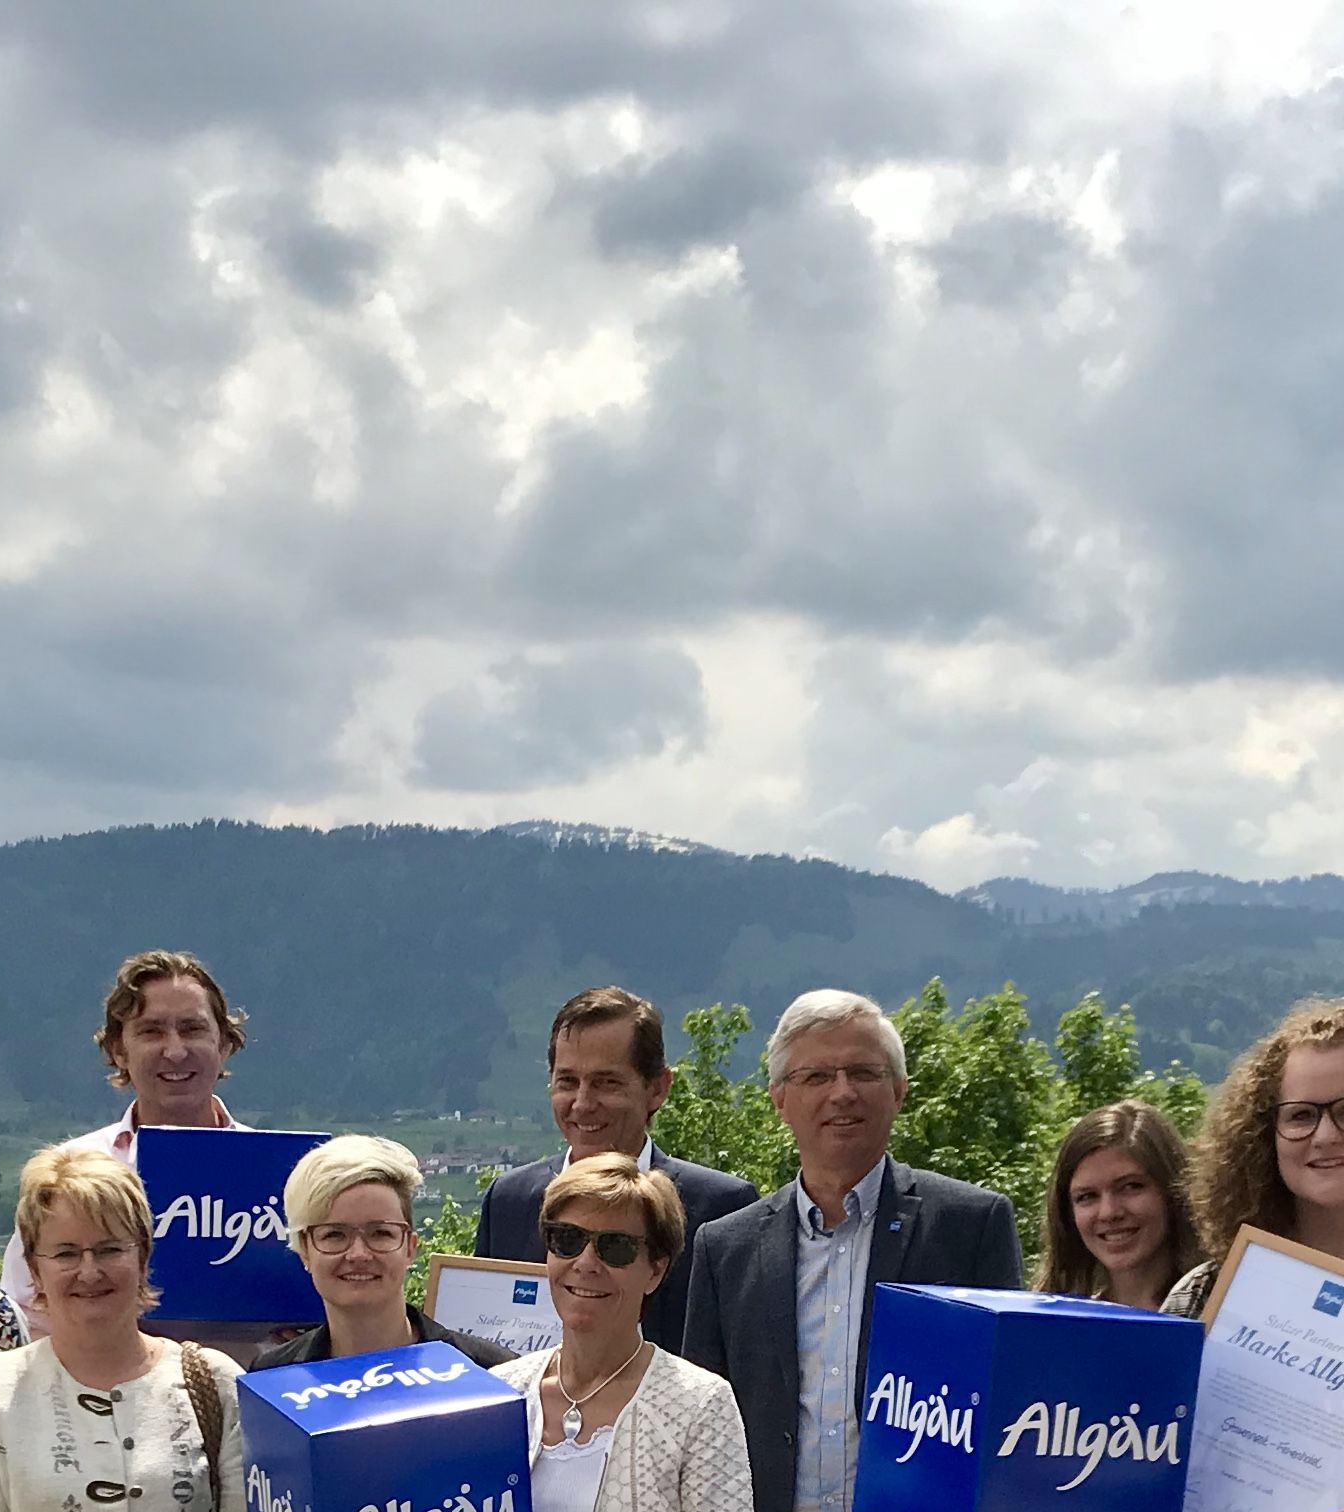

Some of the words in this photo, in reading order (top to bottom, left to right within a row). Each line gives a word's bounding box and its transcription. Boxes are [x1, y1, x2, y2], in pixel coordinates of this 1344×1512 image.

[154, 1195, 290, 1265] Allgä
[476, 1312, 509, 1327] Stolzer
[511, 1316, 549, 1330] Partner
[1226, 1324, 1301, 1368] Marke
[1264, 1313, 1301, 1339] Stolzer
[1302, 1325, 1344, 1354] Partner
[867, 1372, 974, 1464] Allgäu
[997, 1401, 1181, 1492] Allgäu
